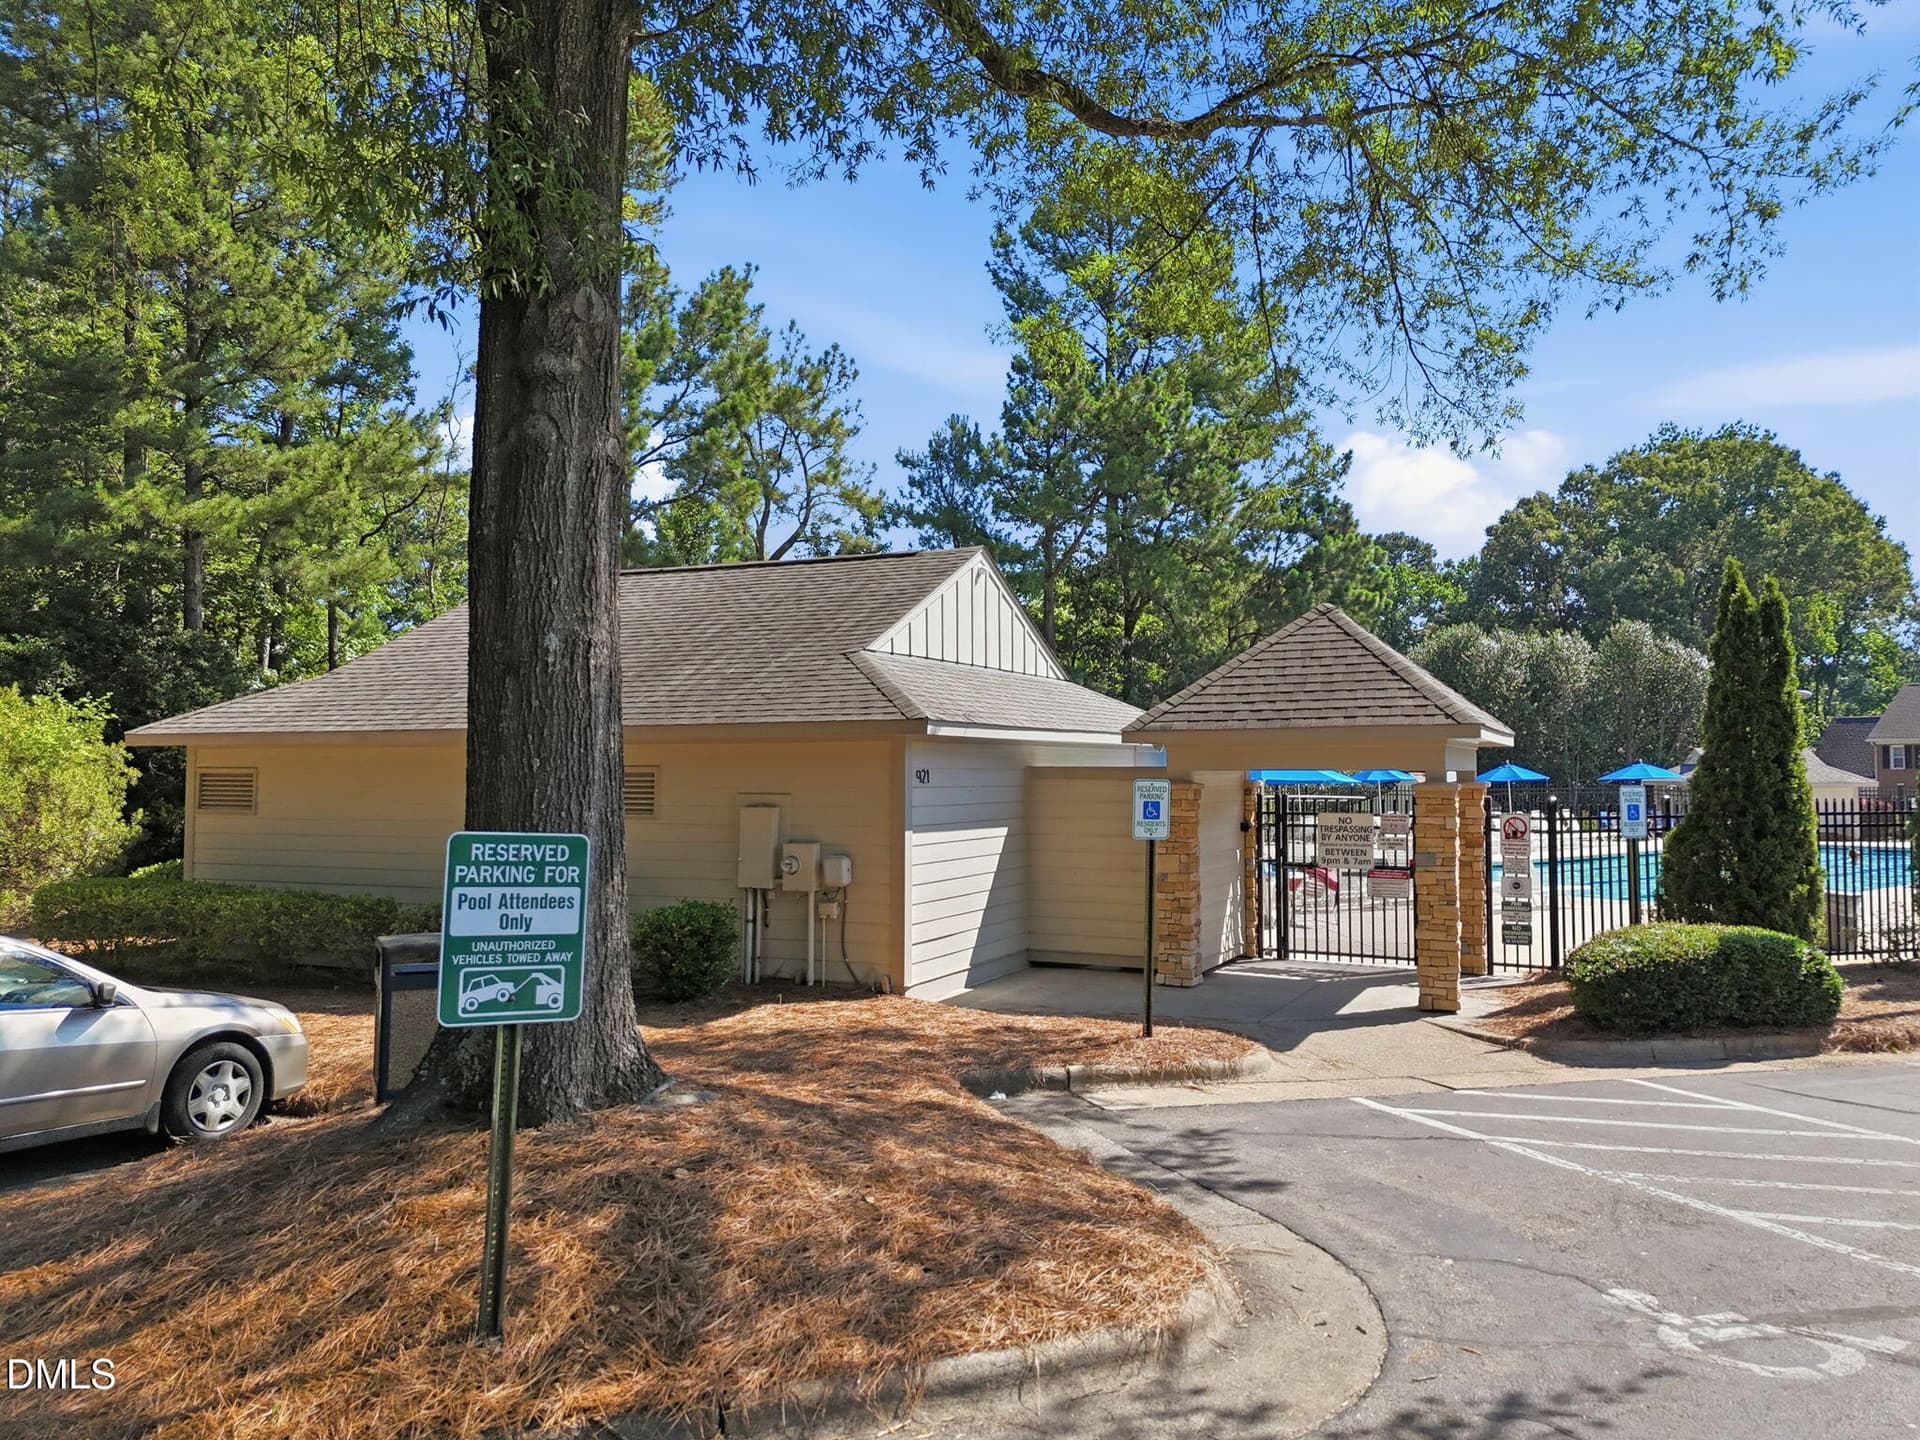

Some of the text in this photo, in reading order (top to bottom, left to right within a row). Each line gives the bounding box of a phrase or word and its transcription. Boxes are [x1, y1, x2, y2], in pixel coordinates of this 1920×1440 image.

[915, 769, 930, 784] 921
[1338, 817, 1352, 825] NO
[1320, 825, 1373, 834] TRESPASSING
[1321, 833, 1371, 842] BY ANYONE
[471, 843, 570, 862] RESERVED
[1325, 848, 1367, 856] BETWEEN
[1321, 857, 1341, 866] 9pm
[1343, 857, 1350, 865] &
[454, 865, 580, 883] PARKING FOR
[457, 893, 575, 910] Pool Attendees
[499, 913, 533, 932] Only
[471, 940, 556, 952] UNAUTHORIZED
[452, 951, 574, 965] VEHICLES TOWED AWAY
